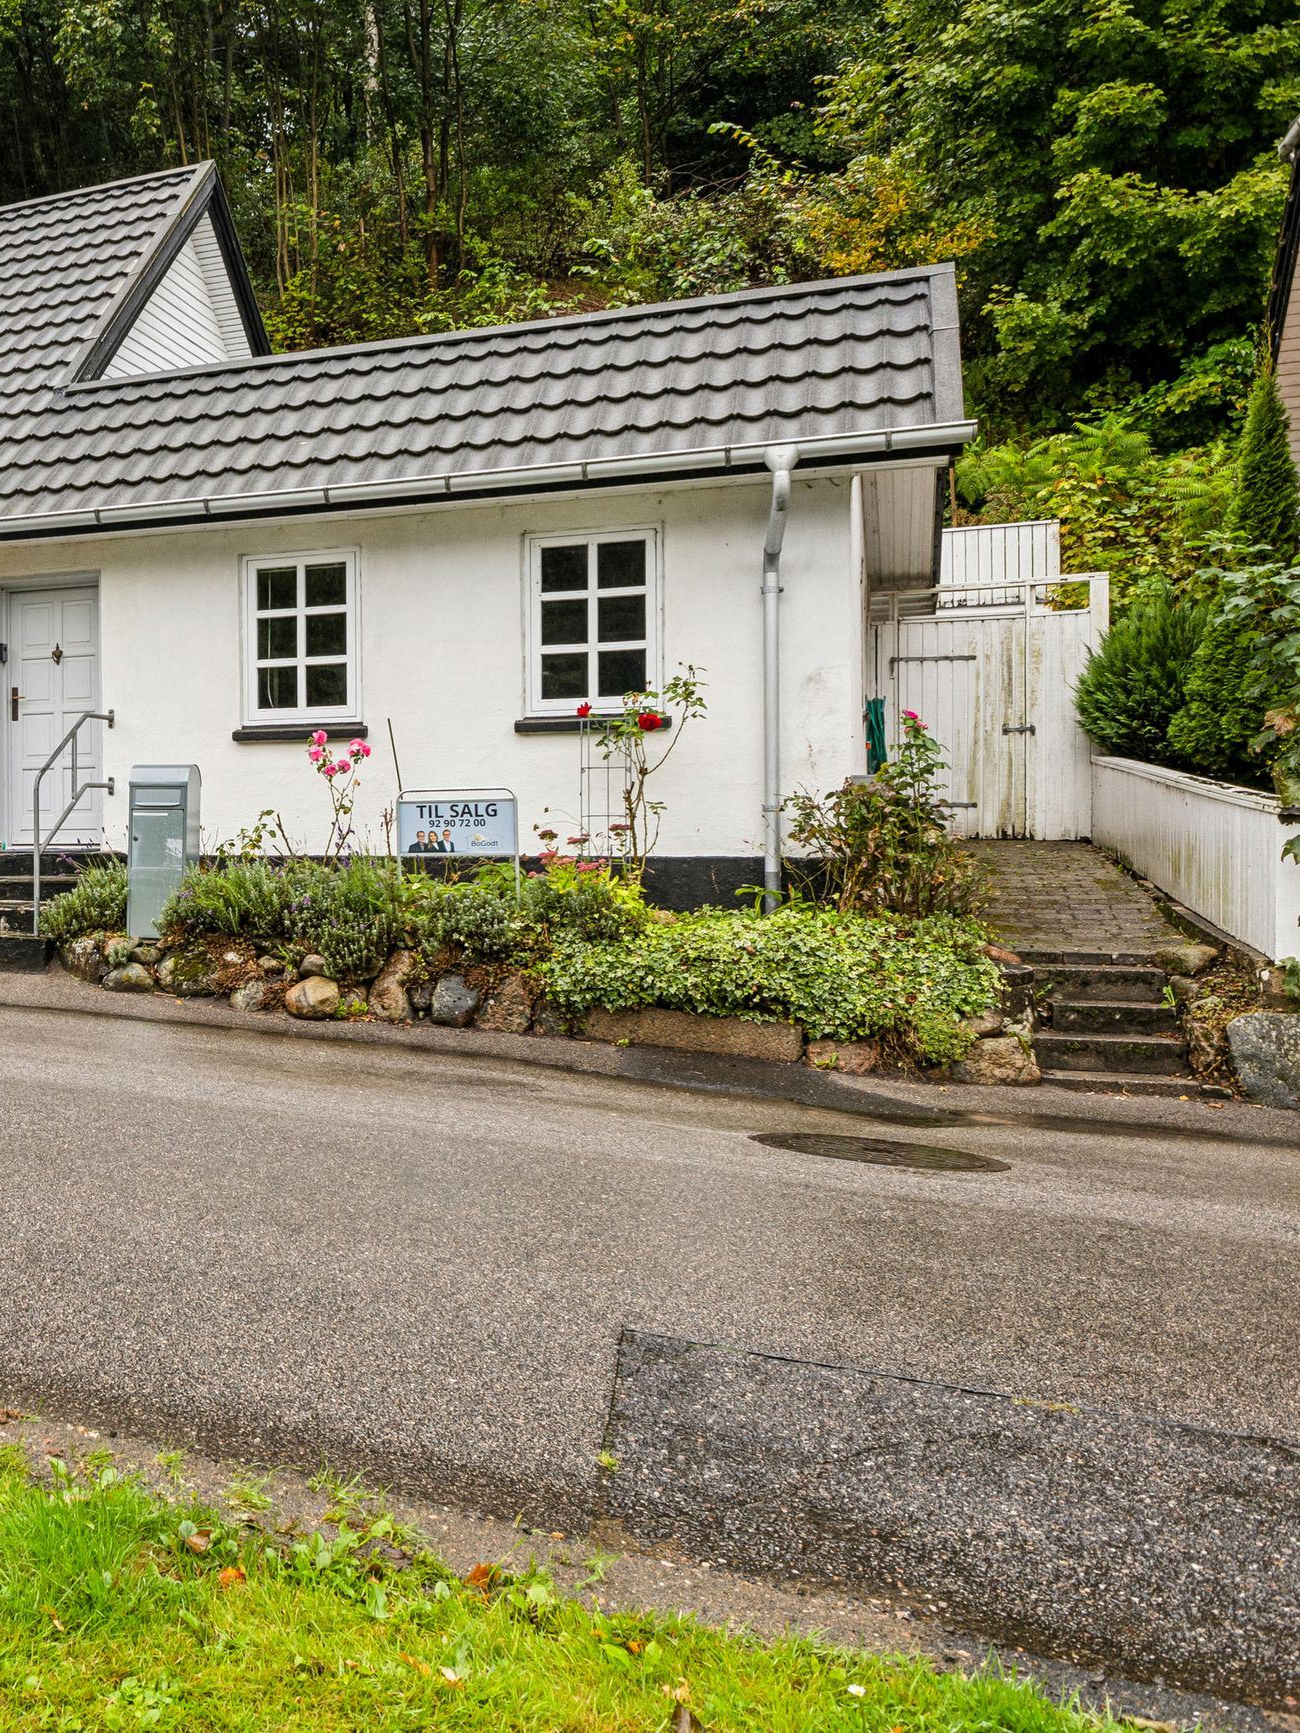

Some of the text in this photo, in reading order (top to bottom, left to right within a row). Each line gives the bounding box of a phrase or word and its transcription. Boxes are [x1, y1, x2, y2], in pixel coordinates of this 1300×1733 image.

[416, 803, 497, 818] TIL SALG
[429, 819, 486, 828] 92 90 72 00
